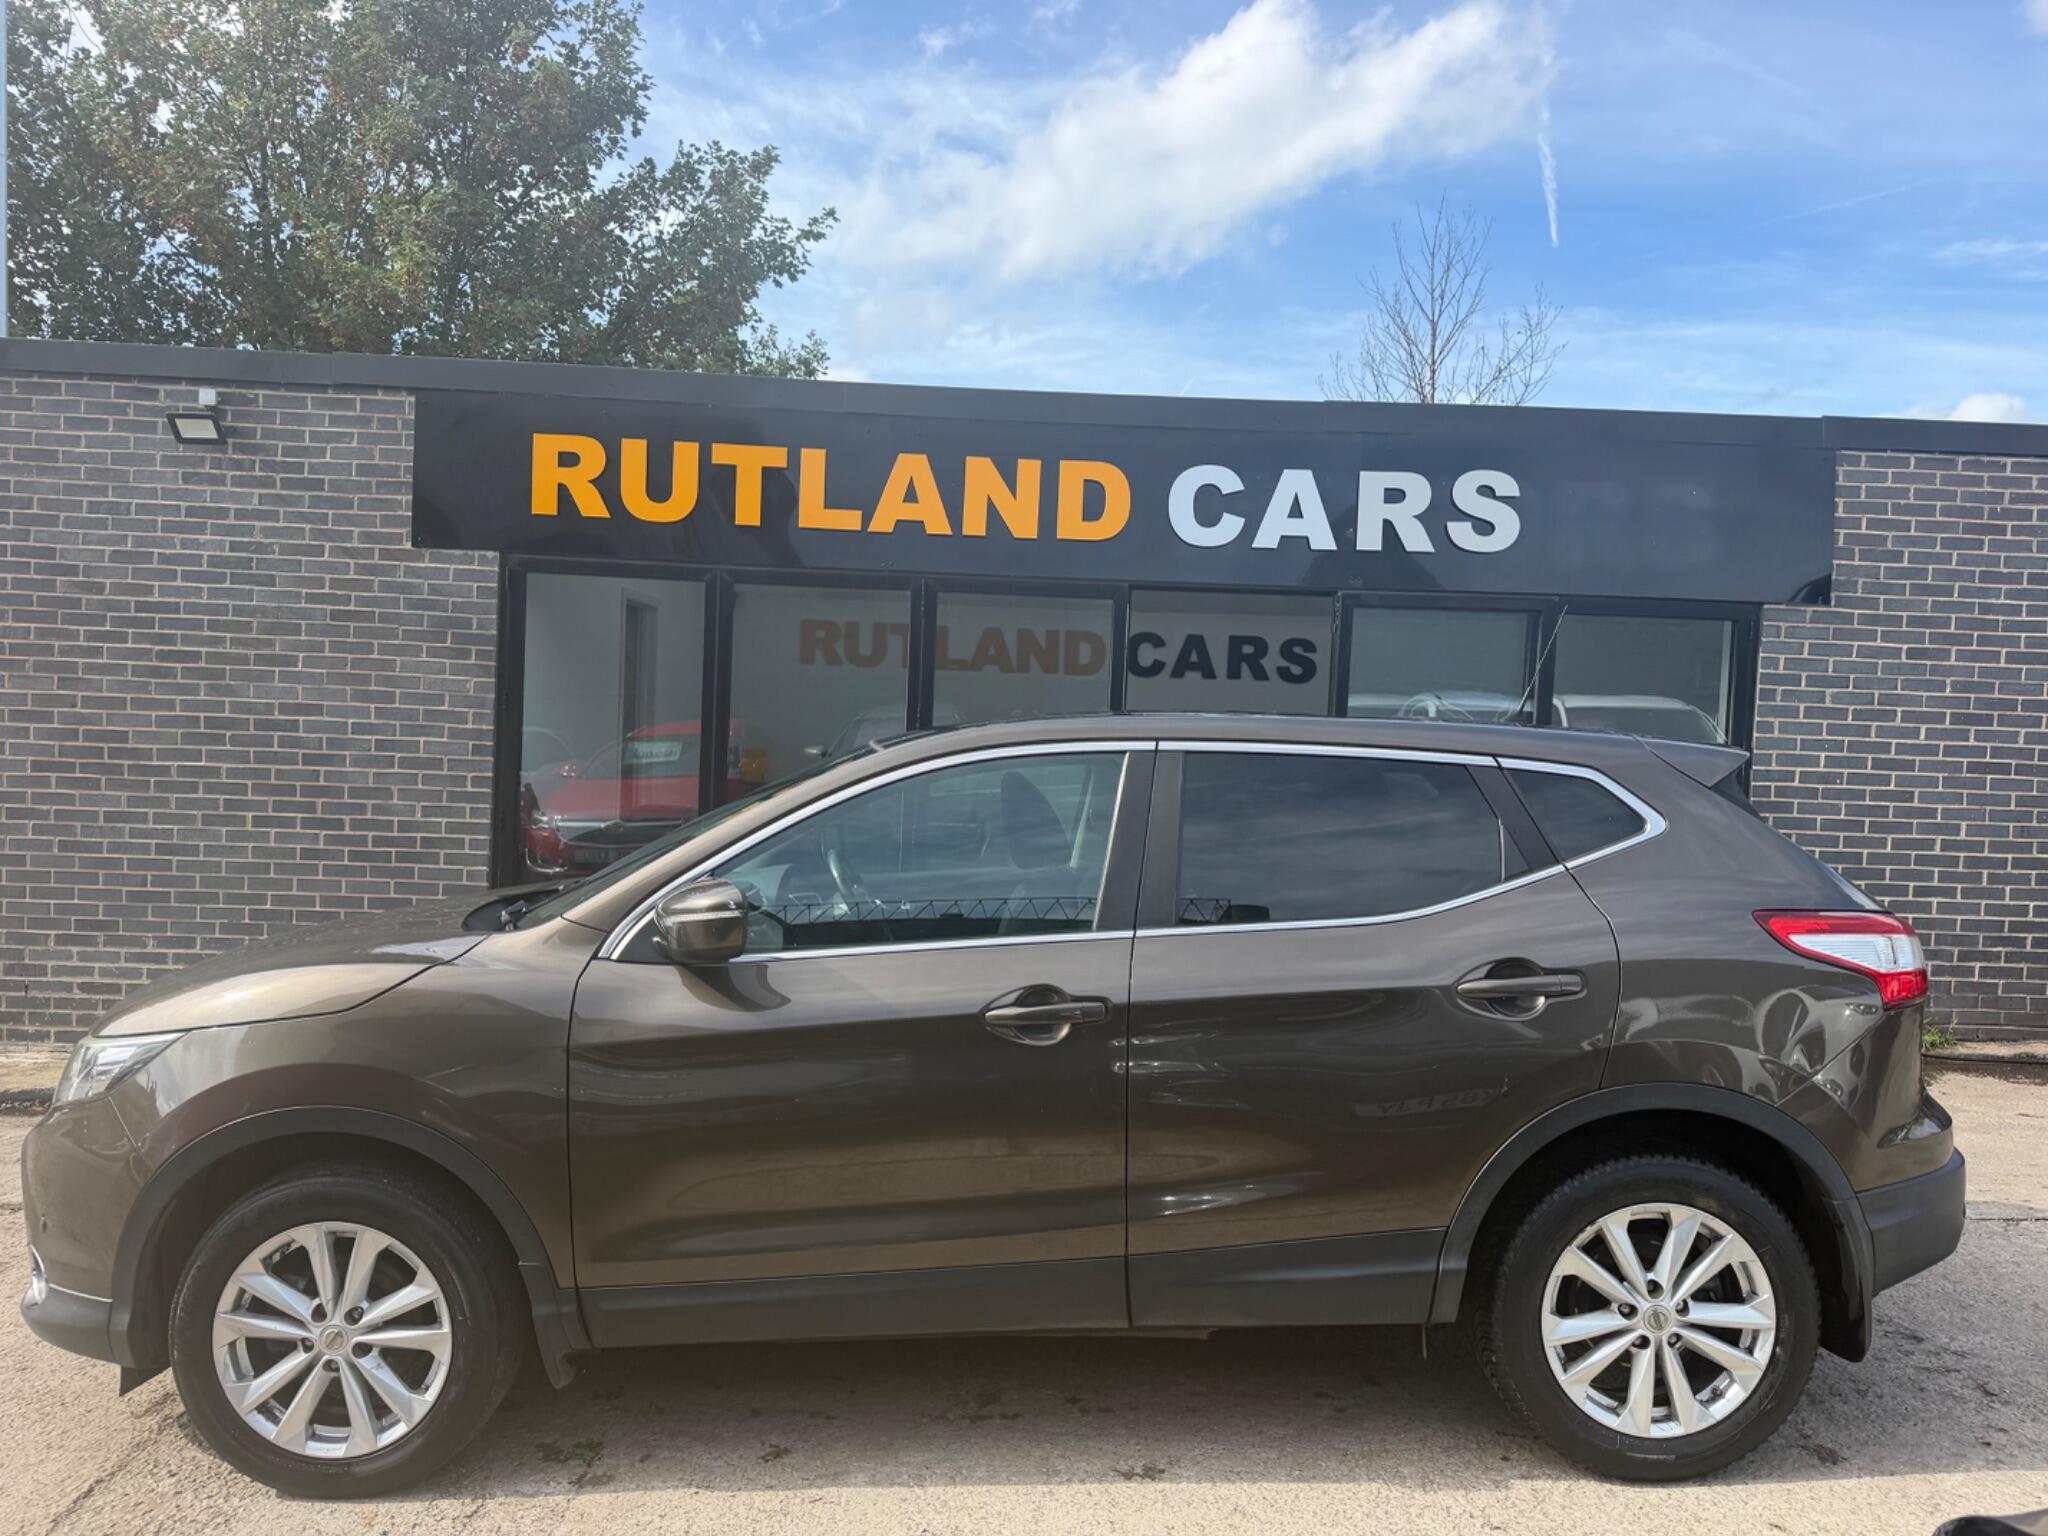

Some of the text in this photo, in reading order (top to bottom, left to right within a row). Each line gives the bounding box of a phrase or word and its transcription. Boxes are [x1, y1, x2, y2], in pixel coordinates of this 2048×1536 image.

[532, 434, 1130, 540] RUTLAND
[1169, 465, 1520, 552] CARS
[1127, 631, 1318, 684] CARS
